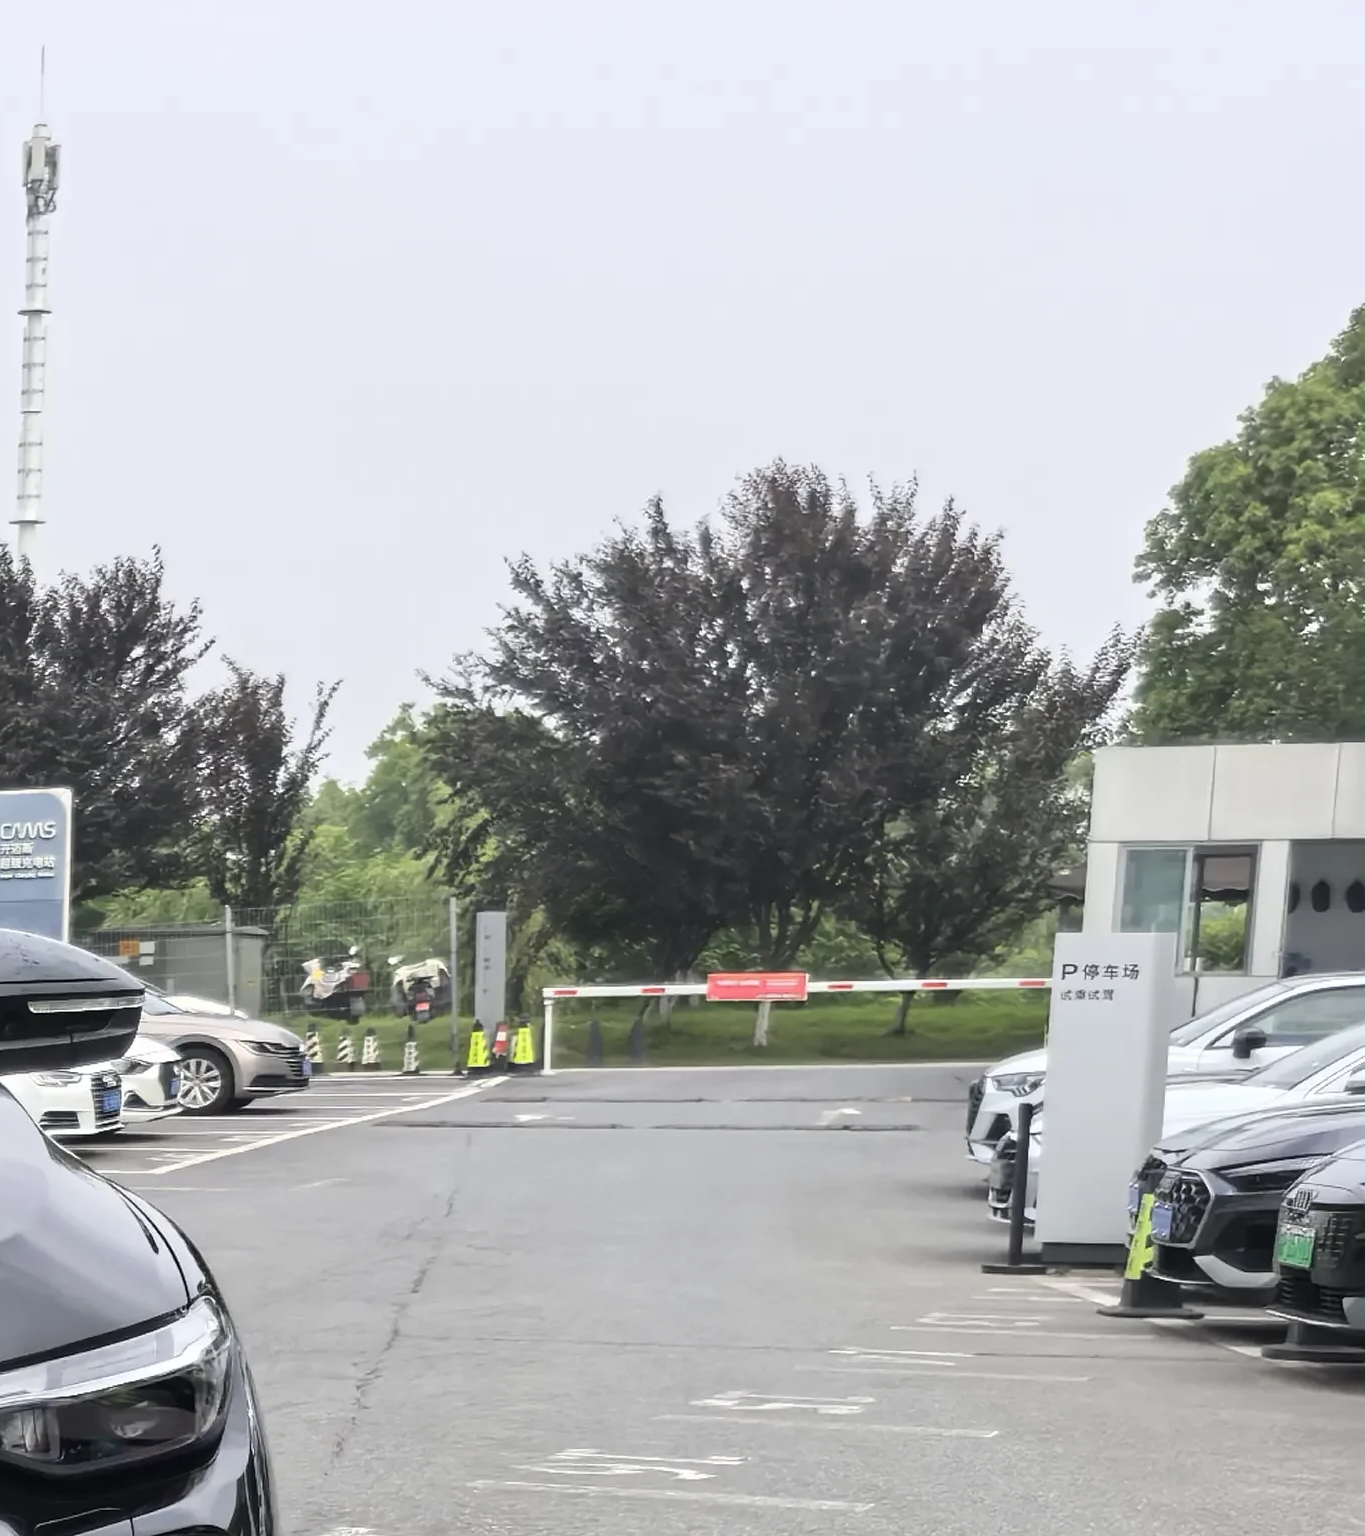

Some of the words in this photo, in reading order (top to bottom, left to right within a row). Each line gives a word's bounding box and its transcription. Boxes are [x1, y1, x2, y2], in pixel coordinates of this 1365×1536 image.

[1061, 963, 1078, 980] P
[1083, 963, 1139, 980] 停车场
